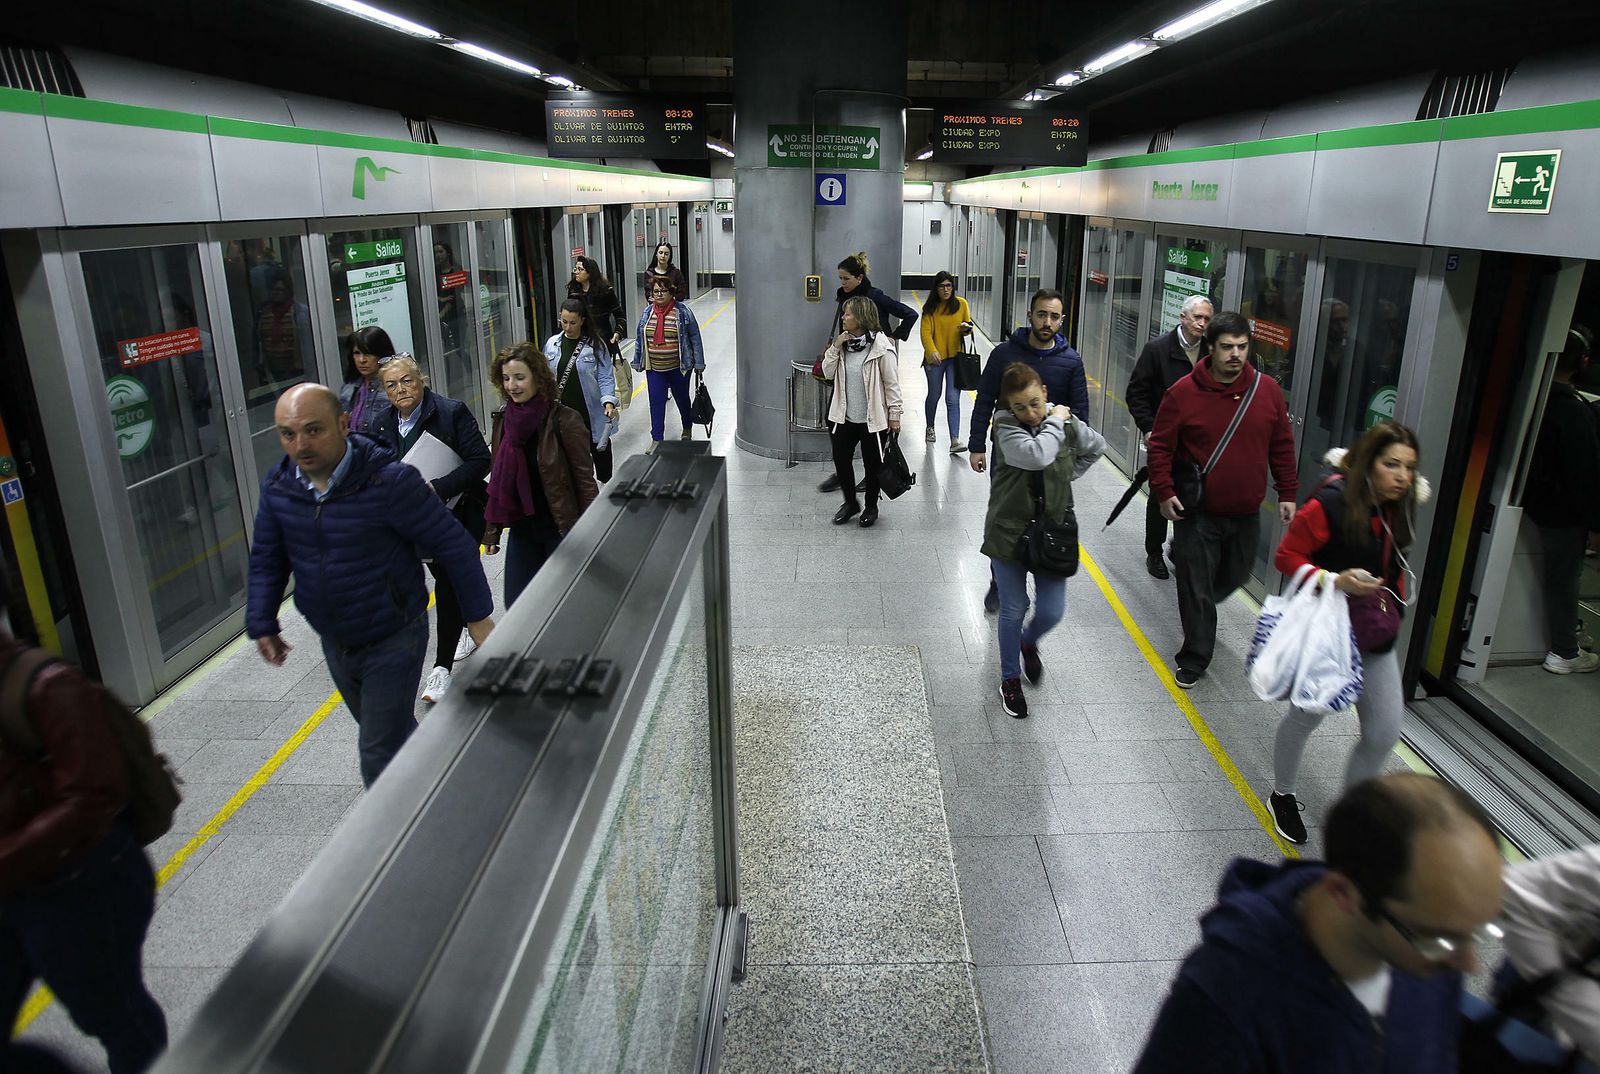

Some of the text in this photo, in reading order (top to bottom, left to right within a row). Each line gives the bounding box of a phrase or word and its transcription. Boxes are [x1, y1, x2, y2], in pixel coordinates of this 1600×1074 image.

[554, 122, 692, 131] OLIVAR DE QUINTOS ENTRA
[784, 134, 866, 144] NO SE DETENGAN
[942, 128, 1078, 139] CIUDAD EXPO ENTRA
[554, 136, 587, 144] OLIVAR
[592, 136, 602, 144] DE
[607, 136, 646, 144] QUINTOS
[942, 140, 974, 149] CIUDAD
[978, 142, 1000, 150] EXPO
[1152, 180, 1218, 201] Puerta Jerez
[375, 242, 401, 257] Salida
[1168, 249, 1188, 266] Salida
[1447, 256, 1458, 270] 5
